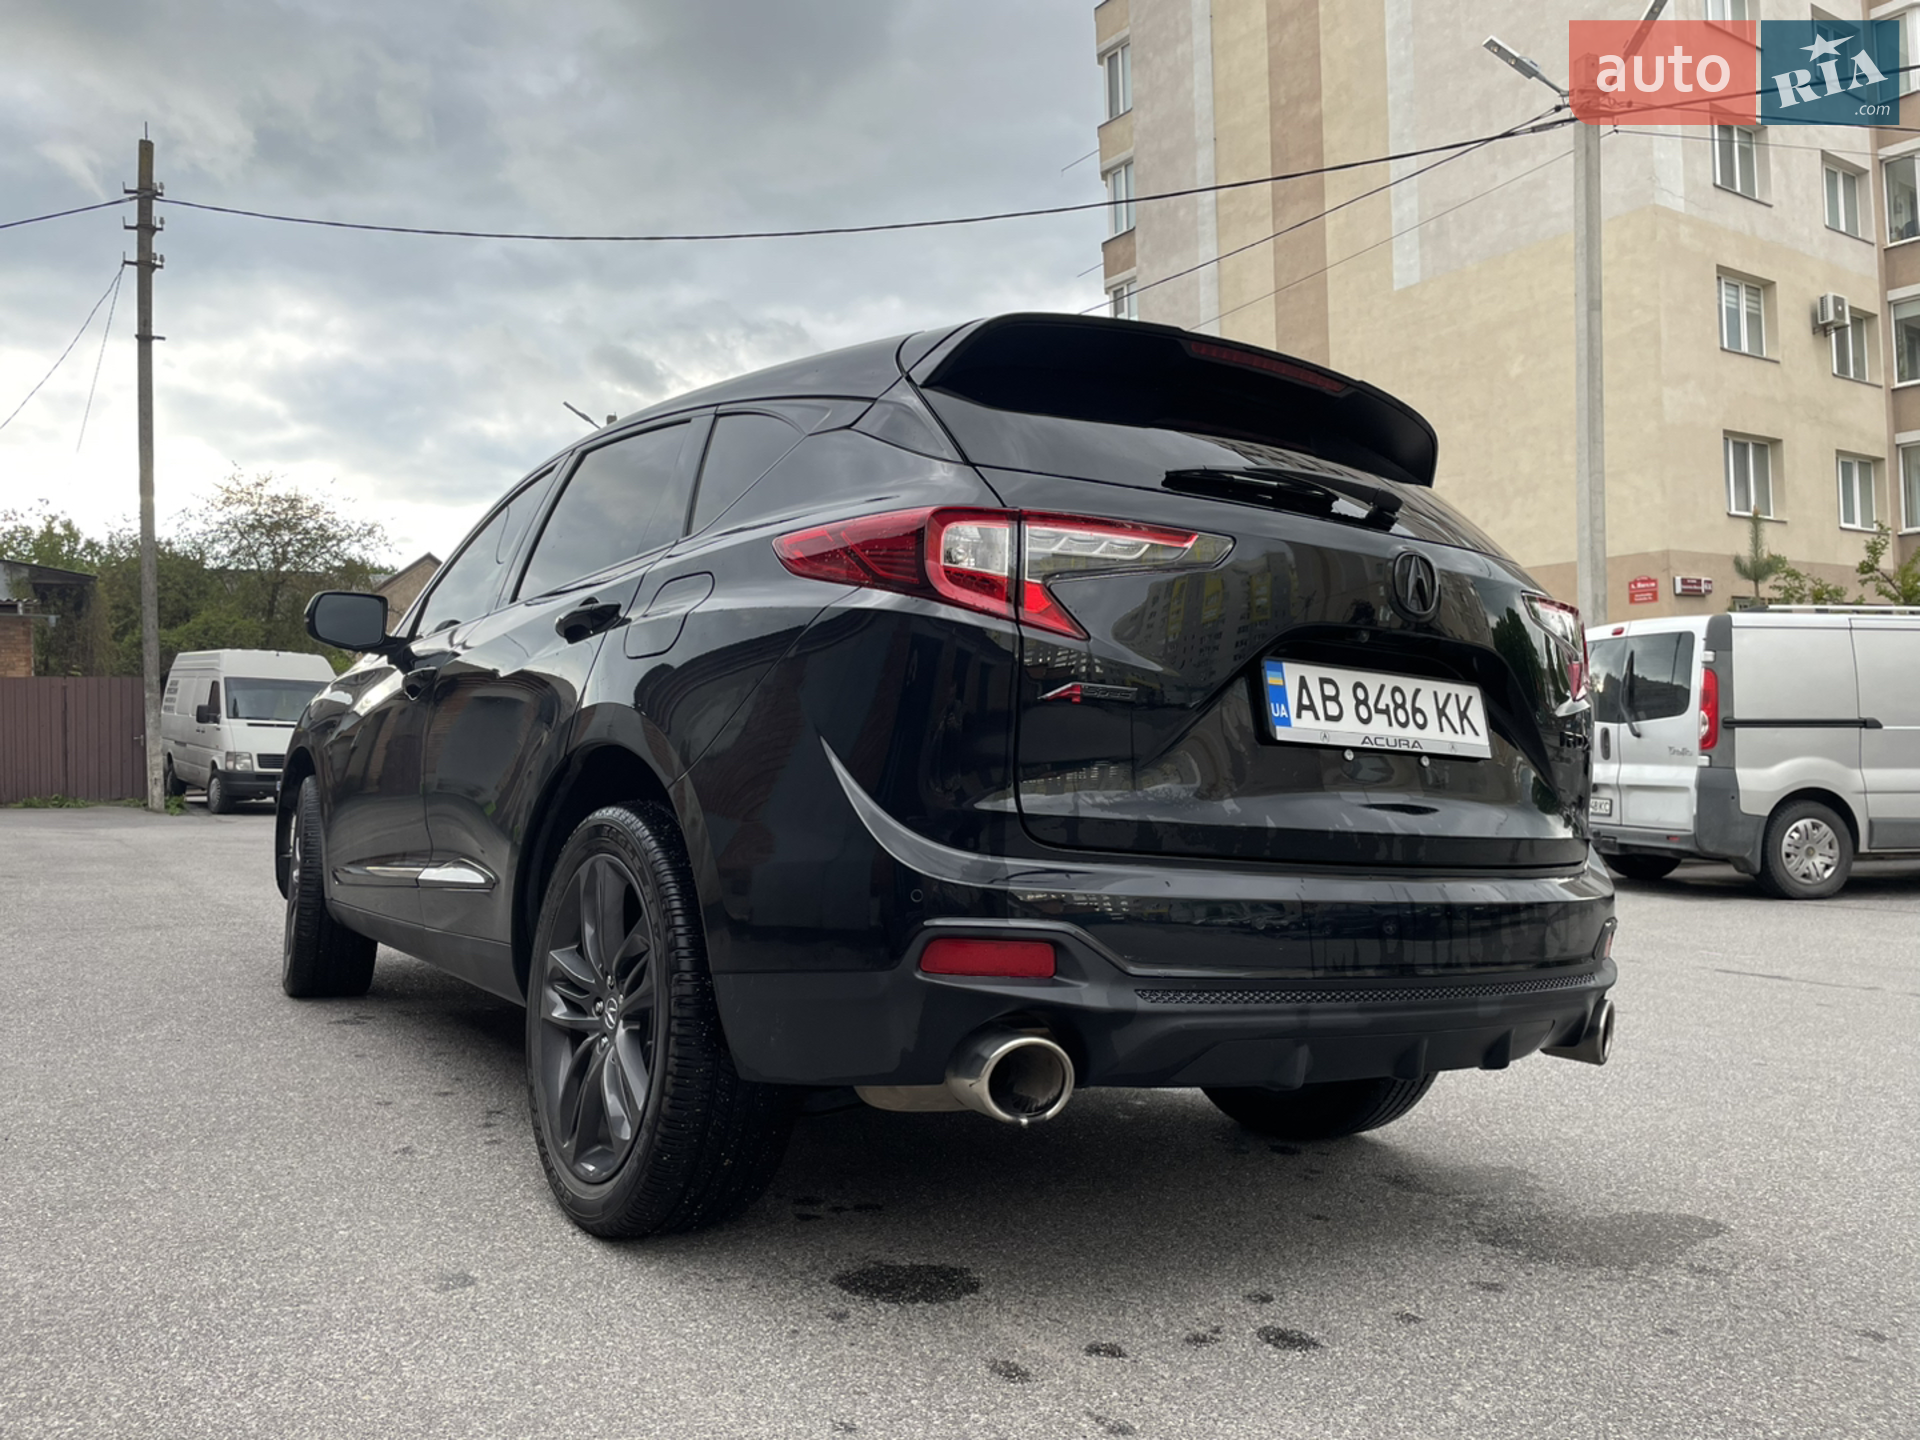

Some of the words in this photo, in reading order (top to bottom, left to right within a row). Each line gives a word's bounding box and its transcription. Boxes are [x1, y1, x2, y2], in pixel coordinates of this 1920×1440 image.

[1271, 703, 1288, 718] UA
[1296, 675, 1343, 722] AB
[1352, 681, 1428, 730] 8486
[1433, 690, 1480, 736] KK
[1361, 735, 1423, 750] ACURA
